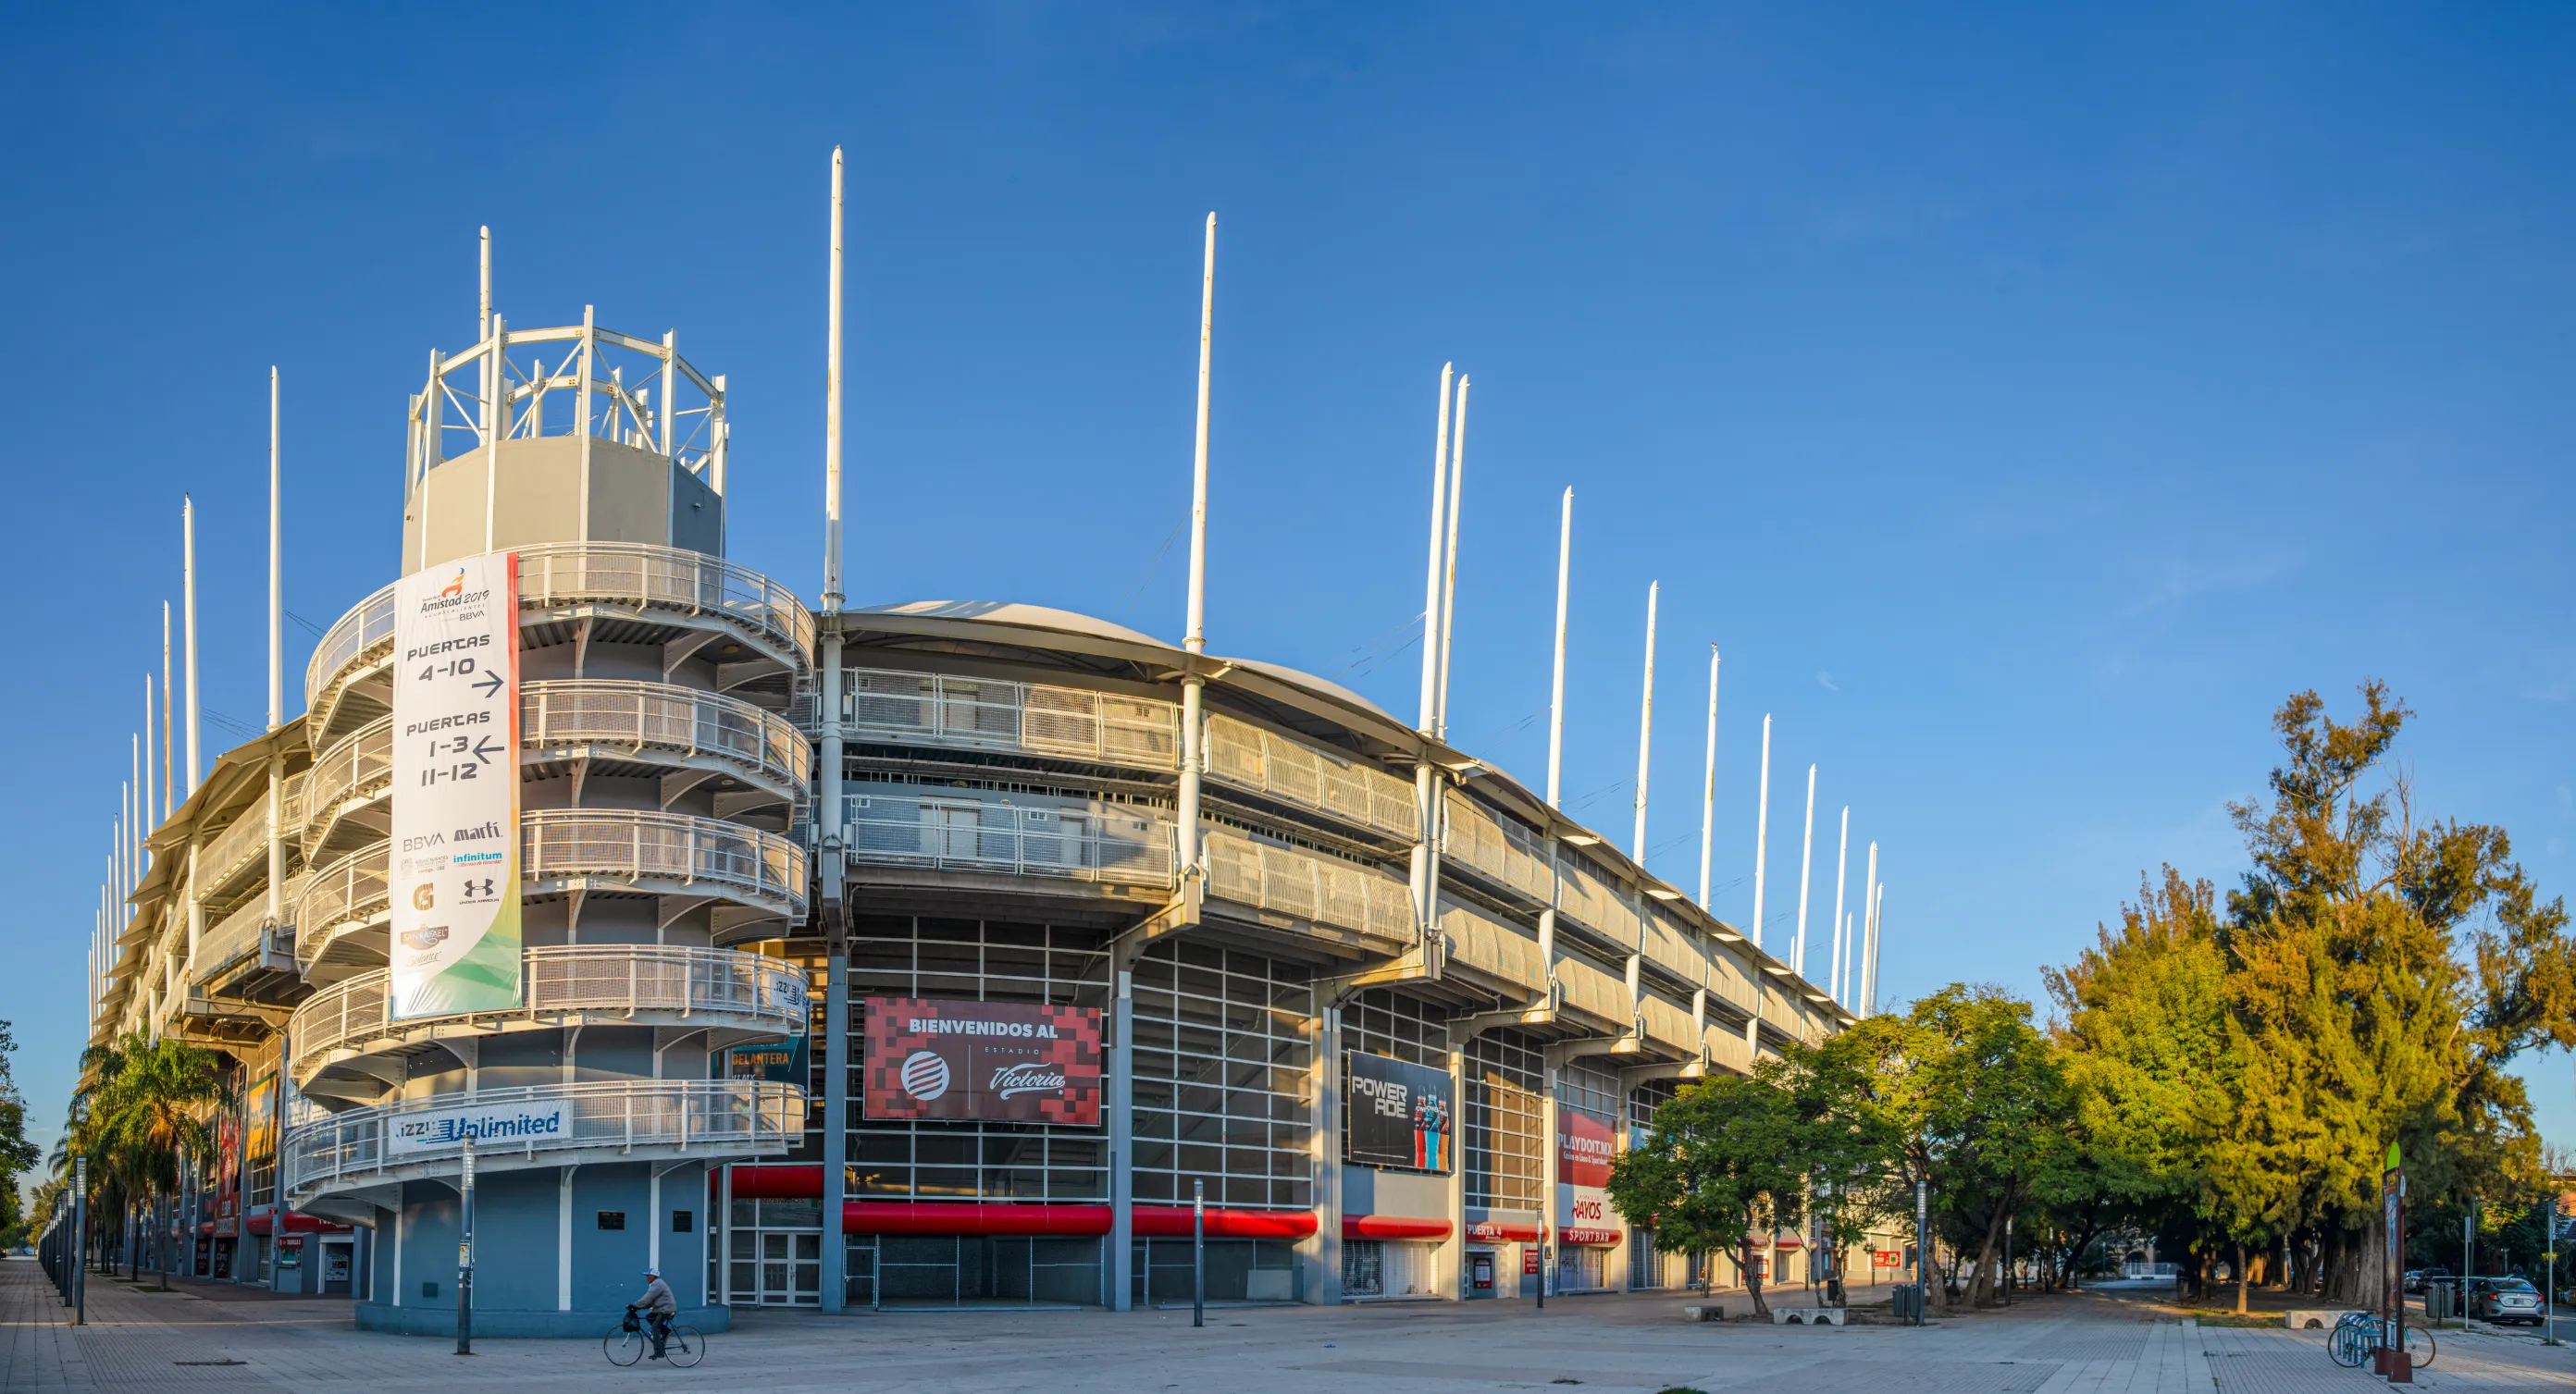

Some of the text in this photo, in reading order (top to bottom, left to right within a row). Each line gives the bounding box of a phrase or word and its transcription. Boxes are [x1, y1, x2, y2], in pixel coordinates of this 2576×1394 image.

[420, 589, 489, 613] Amistad 2019
[459, 610, 485, 622] BBVA
[406, 634, 490, 661] PUERTAS
[418, 658, 476, 681] 4-10
[406, 711, 490, 736] PUERTAS
[429, 735, 469, 758] 1-3
[421, 763, 477, 786] 11-12
[402, 832, 445, 852] BBVA
[452, 852, 502, 863] infinitum
[910, 1018, 1059, 1039] BIENVENIDOS AL
[732, 1052, 789, 1066] DELANTERA
[985, 1046, 1039, 1055] ESTADIO
[989, 1062, 1066, 1098] Victoria
[1352, 1076, 1407, 1102] POWER
[446, 1111, 560, 1142] Unlimited
[1558, 1132, 1614, 1156] PLAYDOIT.MX
[1571, 1200, 1602, 1220] RAYOS
[1467, 1225, 1502, 1236] PUERTA 4
[1568, 1229, 1610, 1242] SPORT BAR
